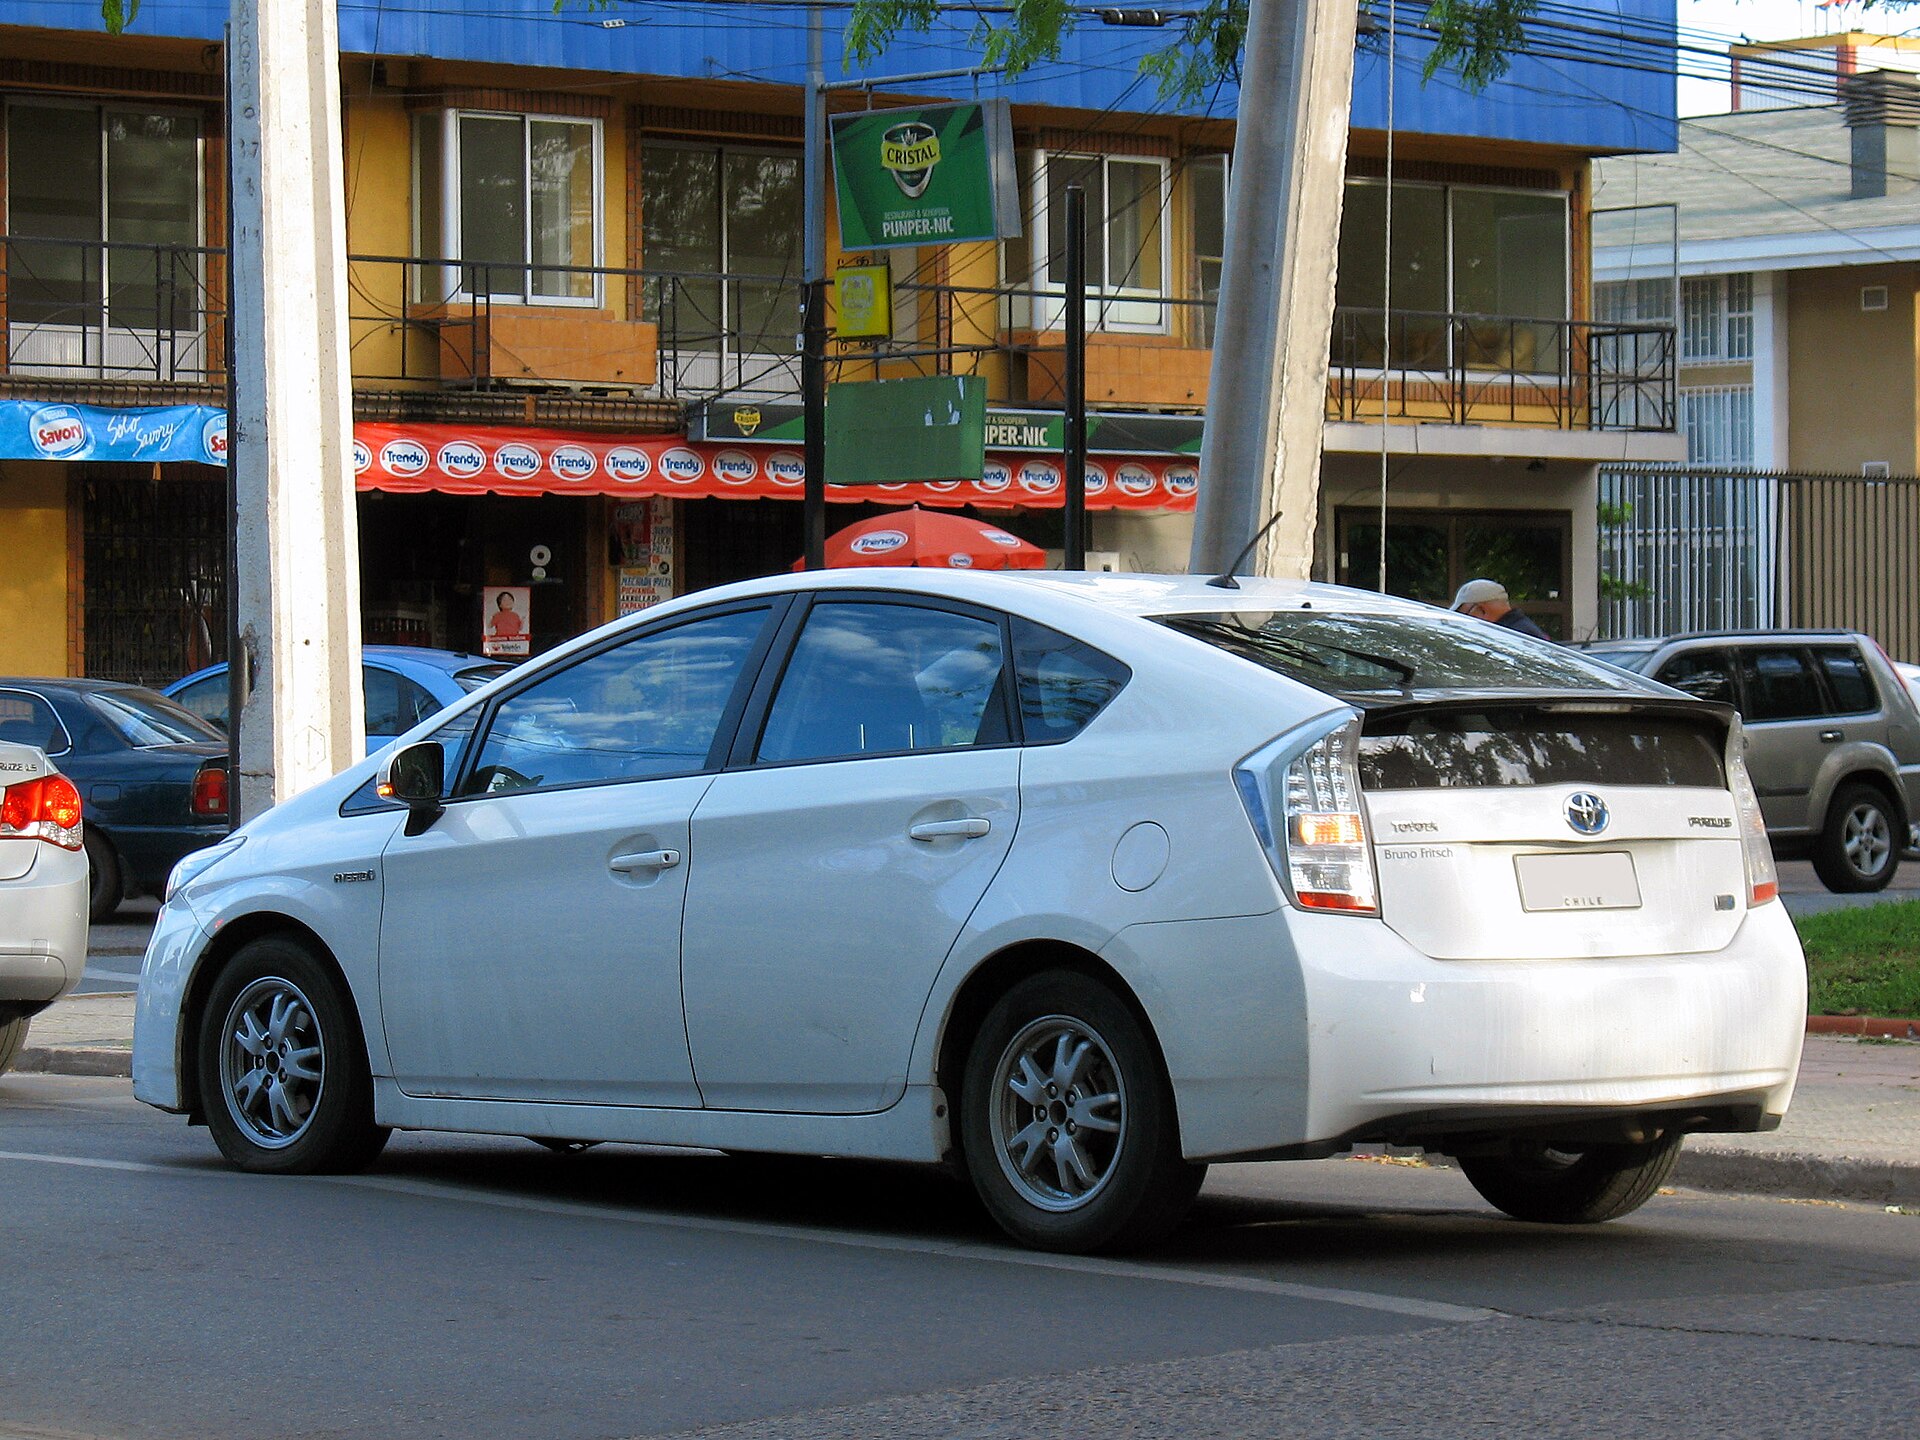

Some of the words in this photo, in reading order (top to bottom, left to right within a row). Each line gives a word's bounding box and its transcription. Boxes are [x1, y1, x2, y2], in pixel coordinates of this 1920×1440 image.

[886, 144, 937, 165] CRISTAL
[882, 216, 954, 237] PUNPER-NIC
[38, 424, 83, 447] Savory
[132, 420, 185, 457] Savory
[387, 451, 424, 467] Trendy
[444, 452, 481, 467] Trendy
[500, 453, 537, 469] Trendy
[556, 454, 592, 470] Trendy
[611, 456, 645, 471] Trendy
[665, 458, 699, 473] Trendy
[719, 458, 753, 474] Trendy
[771, 460, 805, 475] Trendy
[983, 469, 1007, 483] endy
[1024, 470, 1056, 484] Trendy
[1120, 472, 1151, 486] Trendy
[1167, 472, 1196, 486] Trendy
[860, 537, 901, 548] Trendy
[0, 762, 22, 772] RUZE
[1687, 816, 1732, 828] PRIUS
[1384, 849, 1418, 860] Bruno
[1420, 847, 1453, 859] Fritsch
[1563, 895, 1605, 907] CHILE
